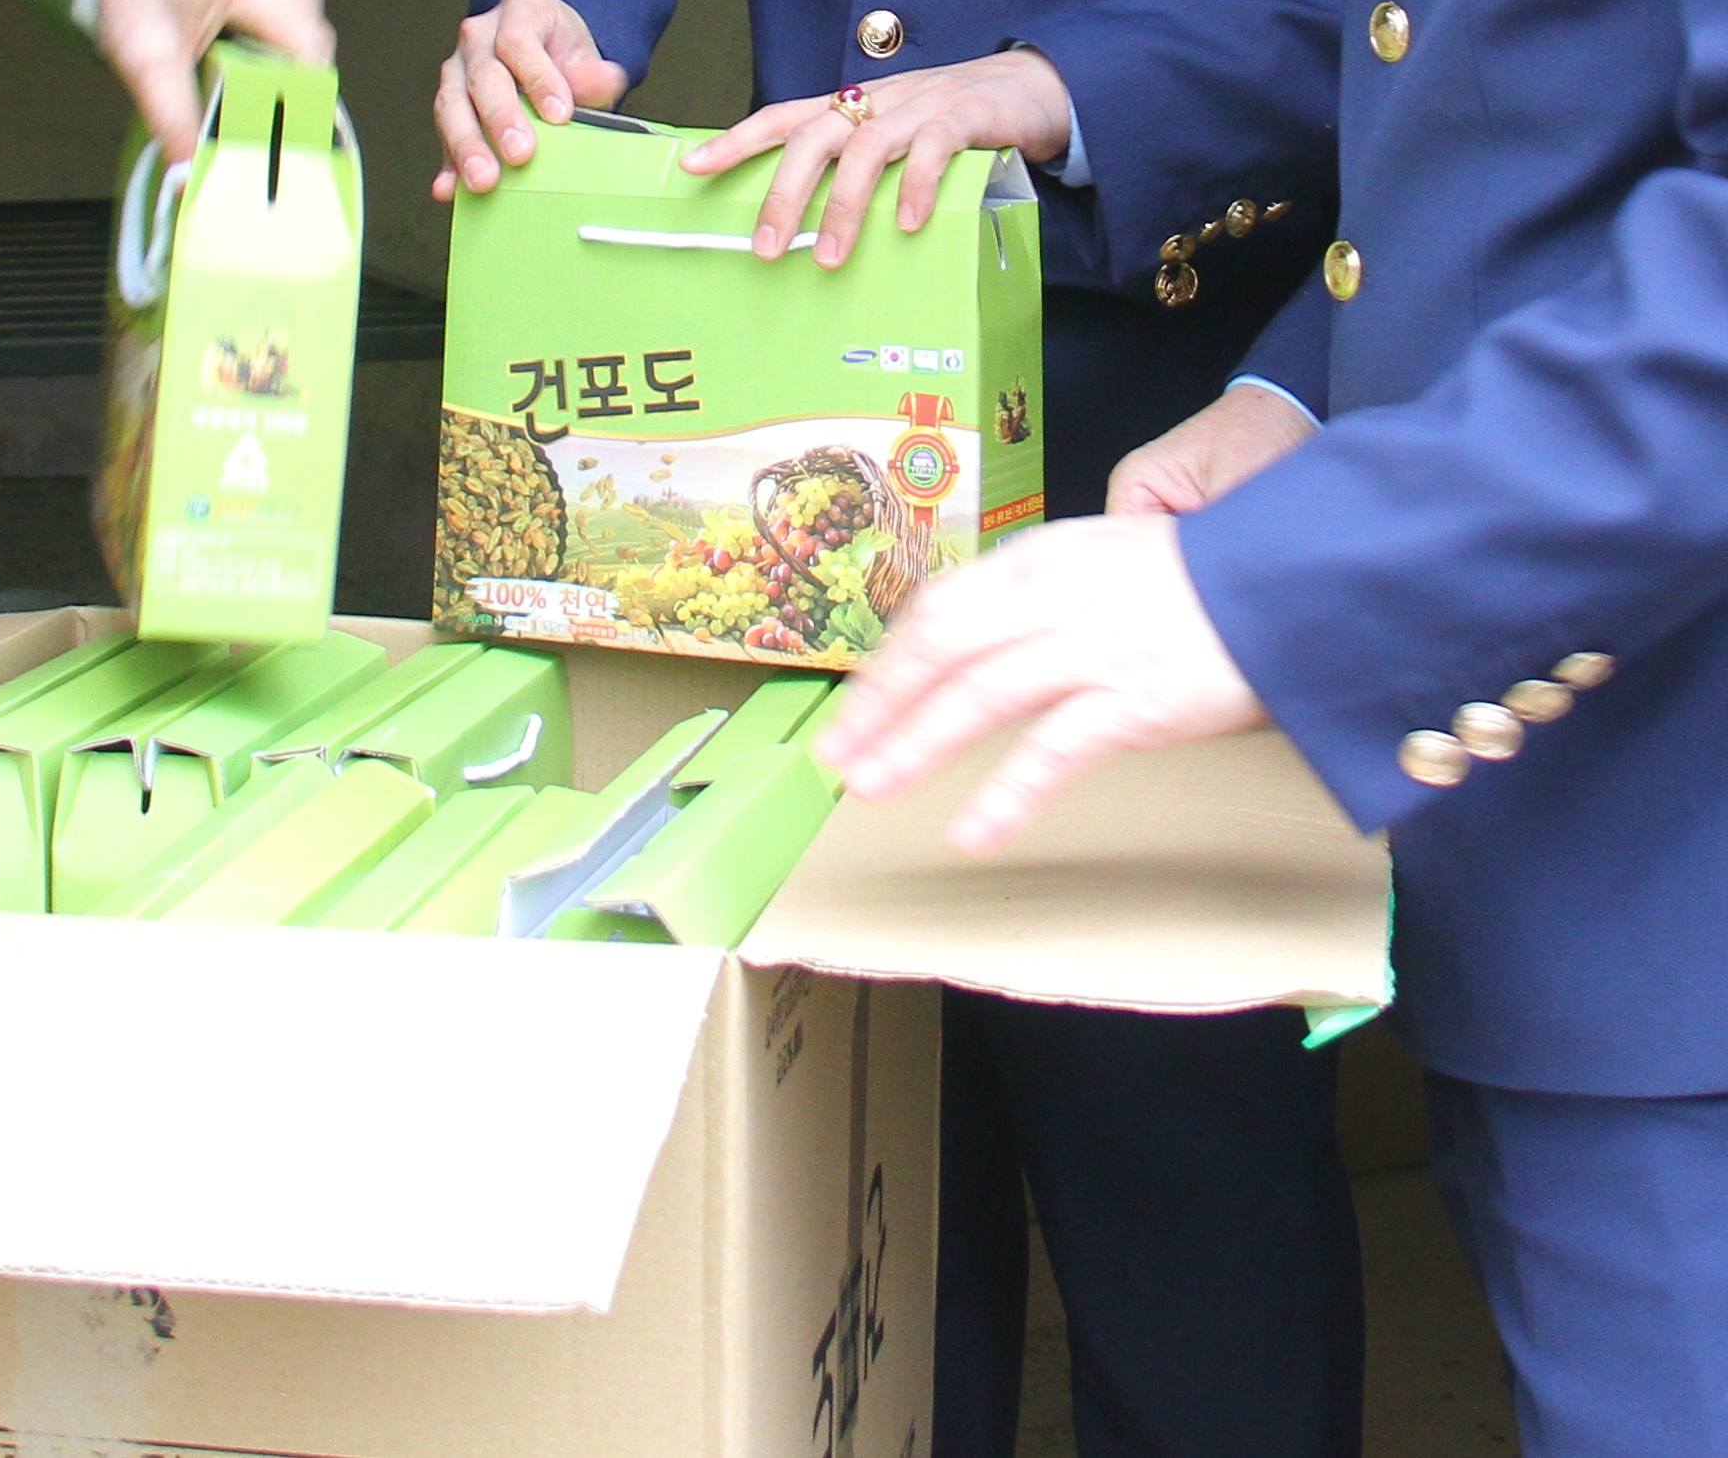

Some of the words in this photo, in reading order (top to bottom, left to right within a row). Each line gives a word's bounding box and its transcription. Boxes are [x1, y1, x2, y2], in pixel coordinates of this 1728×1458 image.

[509, 348, 701, 444] 건포도
[459, 614, 494, 626] NAVER
[482, 580, 547, 610] 100%
[558, 587, 607, 620] 천연
